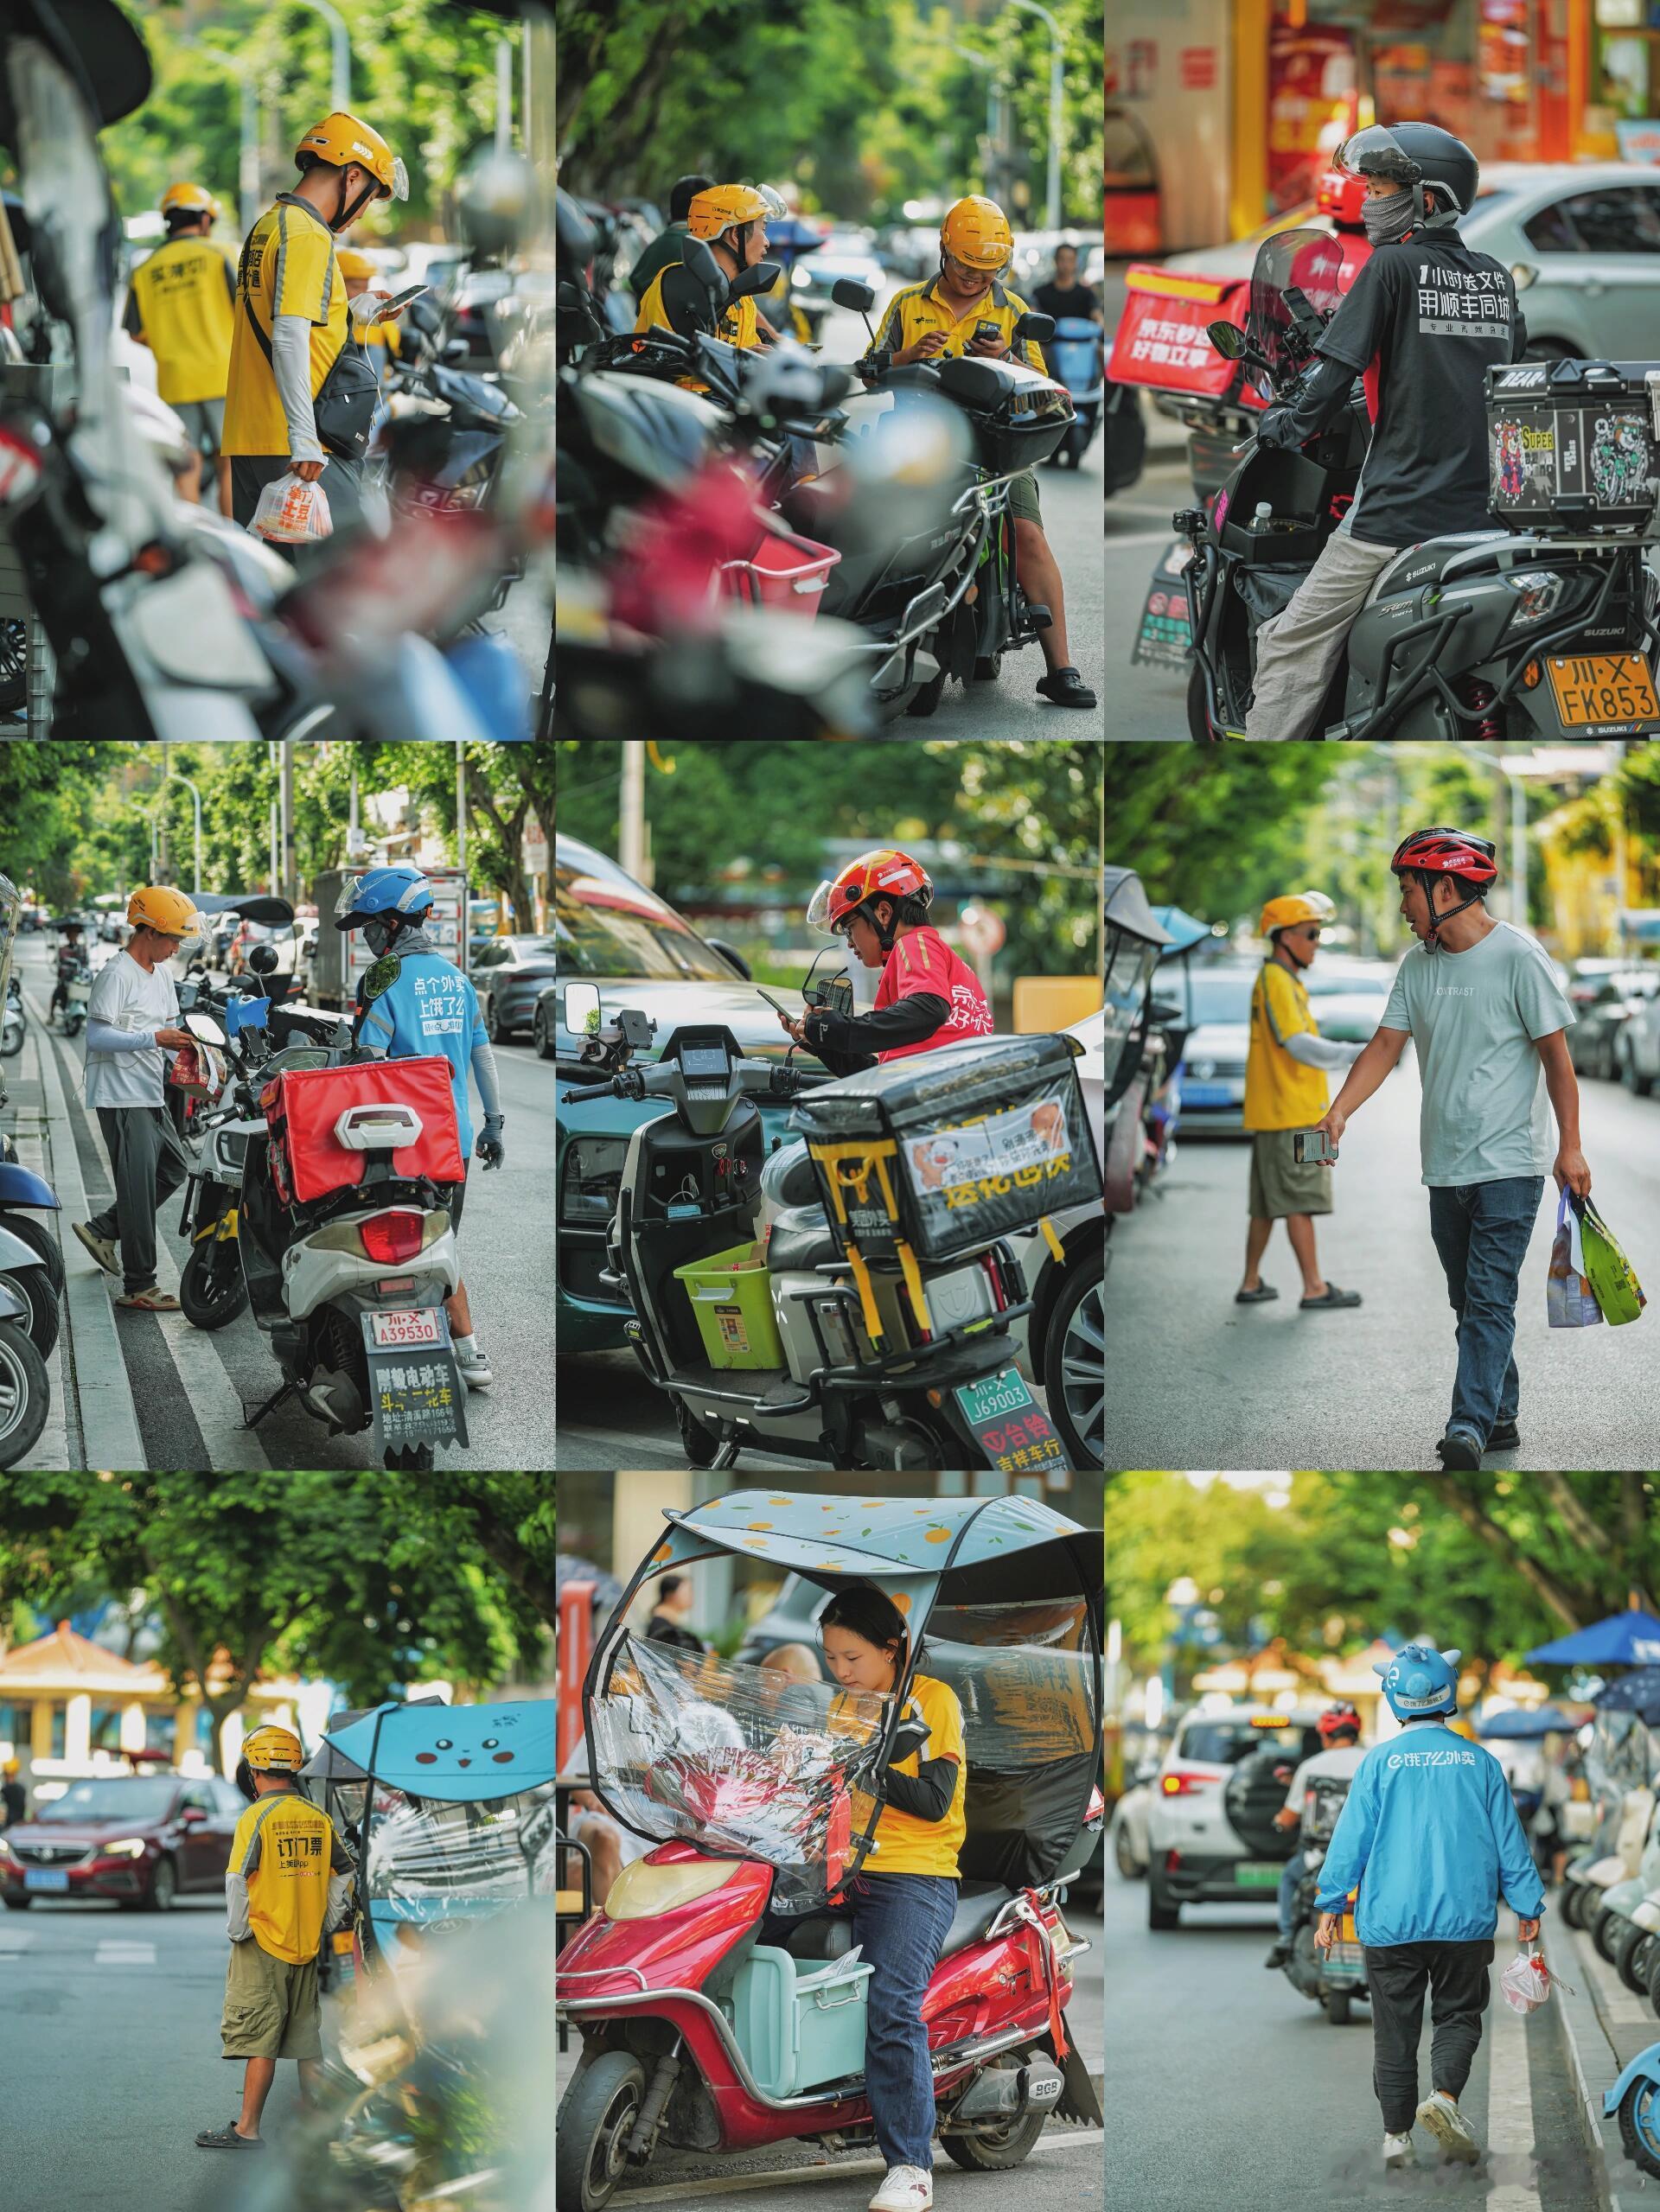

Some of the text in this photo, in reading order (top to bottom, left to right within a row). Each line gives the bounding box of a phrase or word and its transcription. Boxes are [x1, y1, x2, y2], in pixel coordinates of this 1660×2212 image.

[1419, 265, 1505, 291] 1小时送文件
[1418, 289, 1510, 322] 用顺丰同城
[1413, 563, 1435, 578] SUZUKI
[1584, 627, 1625, 636] SUZUKI
[1563, 685, 1653, 721] FK853
[1598, 725, 1627, 734] SUZUKI
[415, 975, 465, 995] 点个外卖
[1433, 986, 1475, 997] ONTRAST
[419, 996, 464, 1018] 上饿了么
[380, 1325, 433, 1342] A39530
[974, 1386, 1025, 1418] J69003
[996, 1438, 1060, 1471] 吉祥车行
[277, 1837, 322, 1858] 订门票
